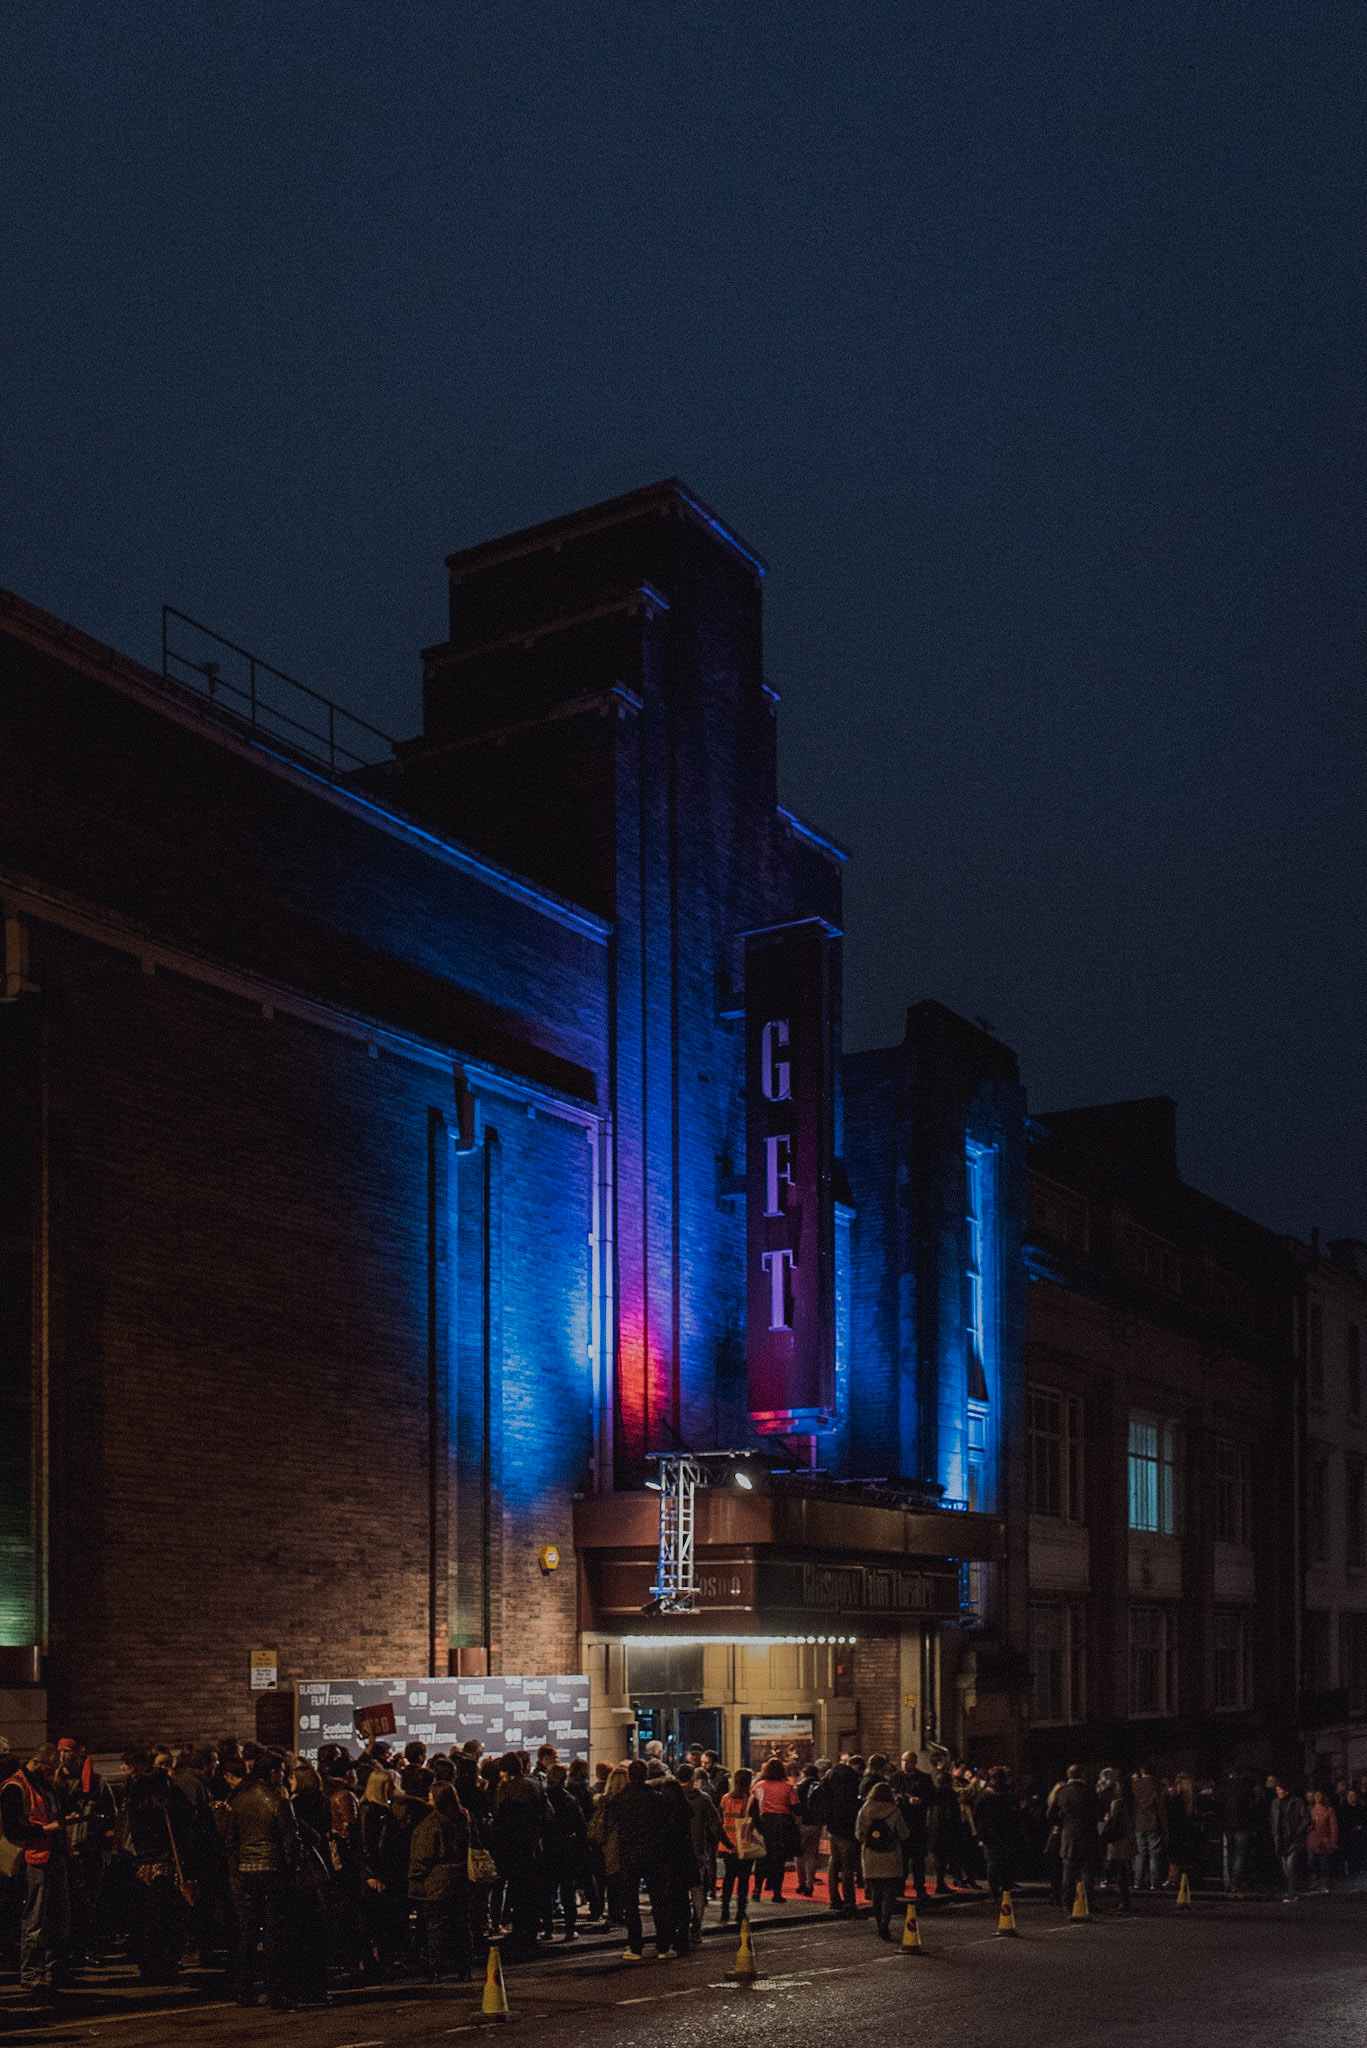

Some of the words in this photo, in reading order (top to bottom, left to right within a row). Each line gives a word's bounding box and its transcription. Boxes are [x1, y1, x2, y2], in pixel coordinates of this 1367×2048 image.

[761, 1019, 796, 1331] GFT
[694, 1574, 741, 1597] osmo
[803, 1563, 859, 1608] Glasgow
[862, 1567, 889, 1606] Film
[299, 1684, 325, 1695] GLASGOW
[311, 1695, 325, 1706] FILM
[329, 1694, 354, 1706] FESTIVAL
